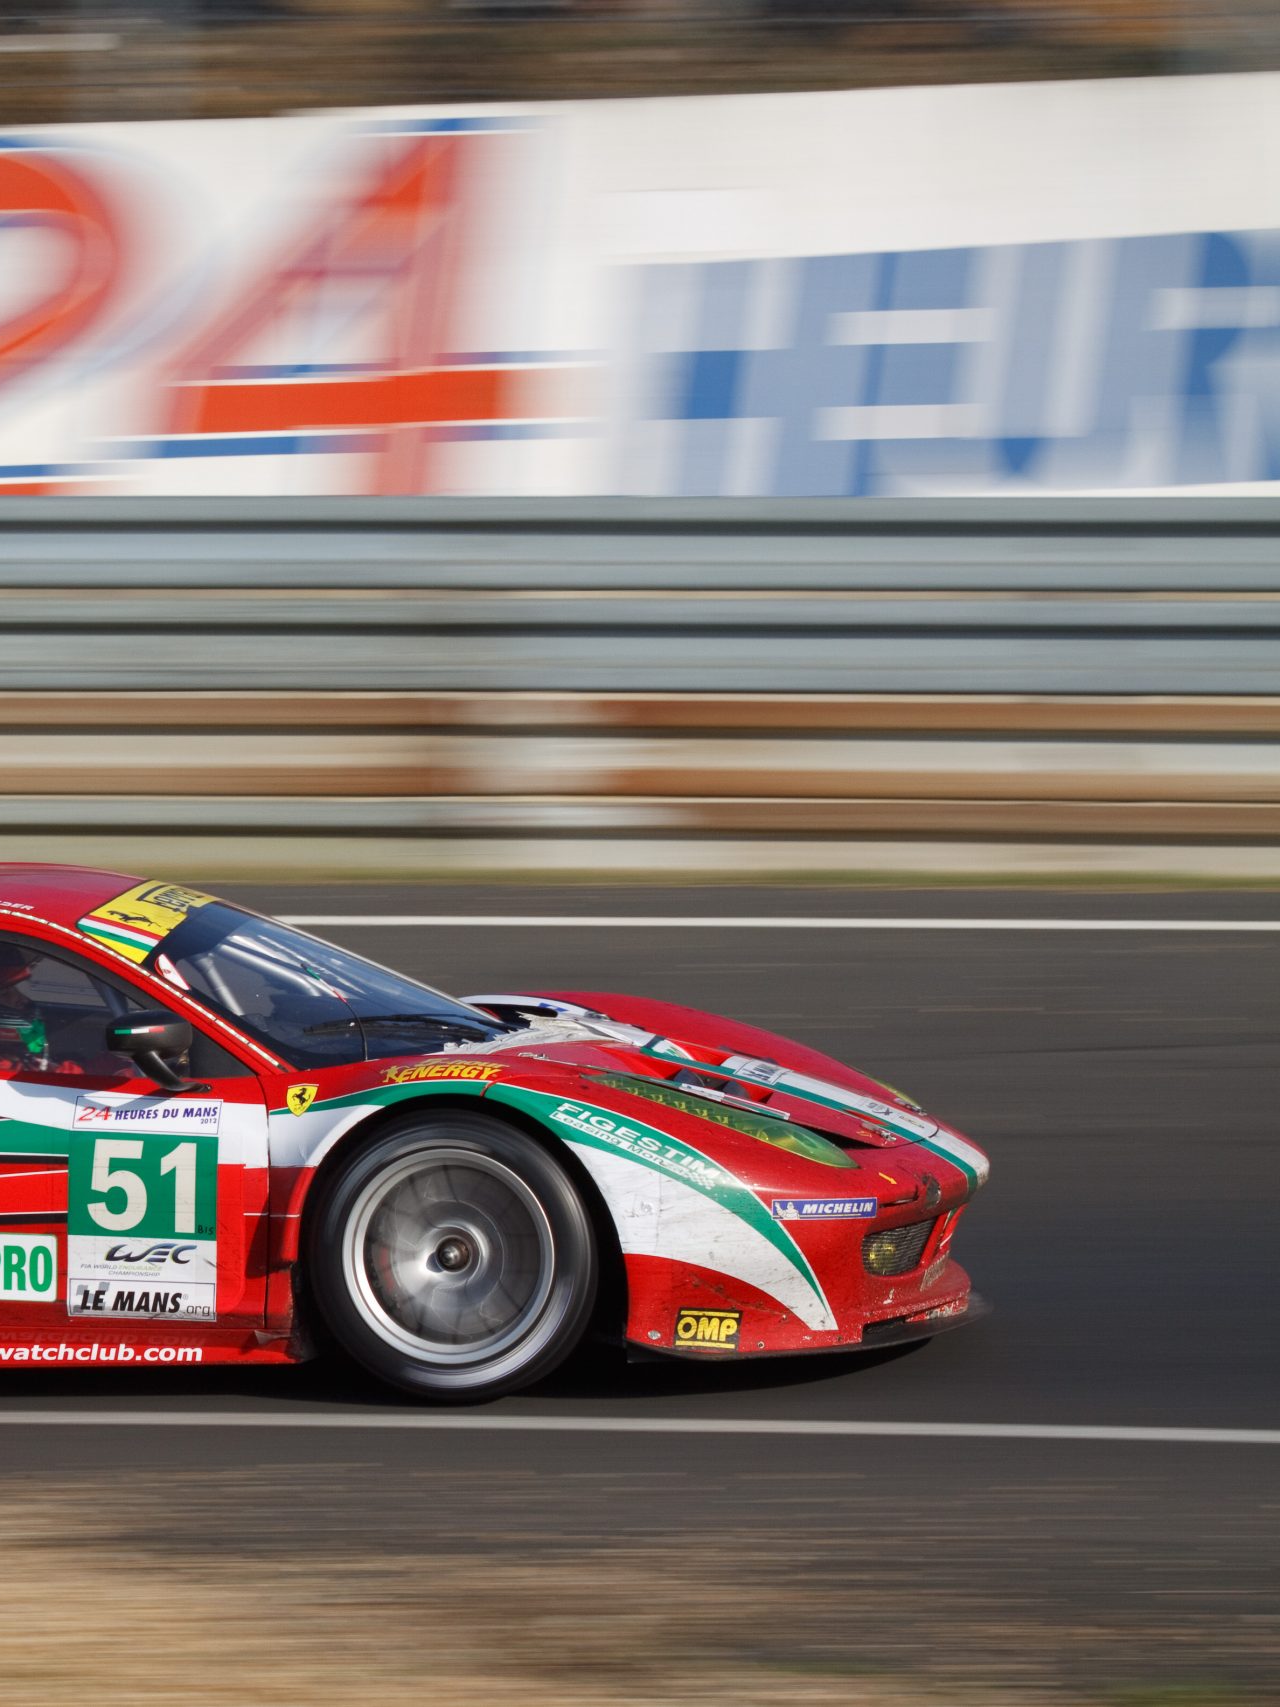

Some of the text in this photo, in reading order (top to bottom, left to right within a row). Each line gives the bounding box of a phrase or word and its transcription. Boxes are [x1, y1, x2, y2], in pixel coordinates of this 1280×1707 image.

[401, 1064, 503, 1081] ENERGY
[78, 1105, 219, 1122] 24 HEURES DU MANS
[552, 1112, 621, 1146] Leasing
[556, 1102, 721, 1179] FIGESTIM
[87, 1138, 198, 1234] 51
[802, 1202, 874, 1214] MICHELIN
[105, 1243, 198, 1265] WEC
[80, 1289, 106, 1311] LE
[111, 1290, 183, 1314] MANS
[677, 1316, 738, 1342] OMP
